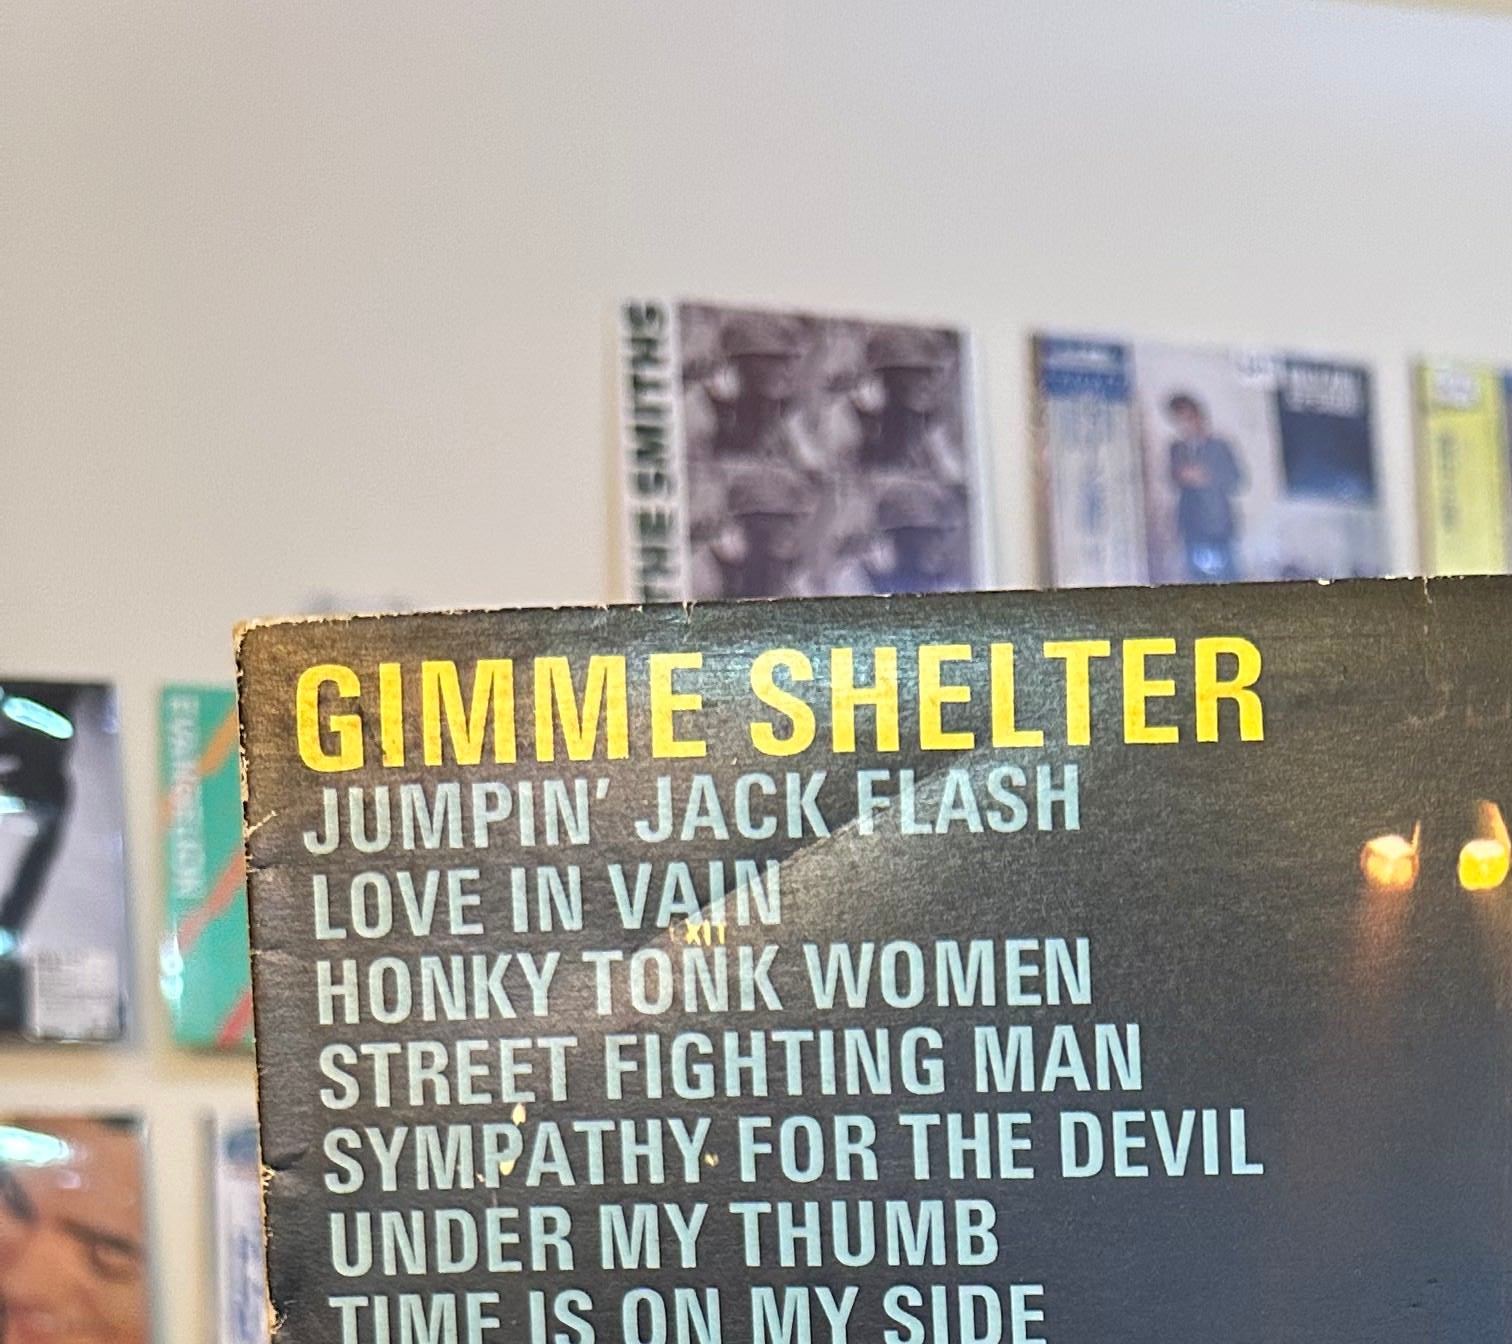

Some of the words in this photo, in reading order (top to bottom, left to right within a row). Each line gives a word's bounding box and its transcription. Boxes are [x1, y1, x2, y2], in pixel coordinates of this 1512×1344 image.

[623, 302, 675, 497] SMITHS
[294, 651, 707, 773] GIMME
[747, 636, 1265, 760] SHELTER
[301, 774, 612, 856] JUMPIN'
[633, 768, 832, 845] JACK
[855, 762, 1081, 838] FLASH
[311, 867, 484, 941] LOVE
[509, 863, 583, 934] IN
[605, 858, 783, 930] VAIN
[315, 950, 562, 1027] HONKY
[581, 943, 785, 1017] TONK
[802, 937, 1092, 1011] WOMEN
[317, 1034, 579, 1110] STREET
[603, 1026, 945, 1100] FIGHTING
[973, 1022, 1143, 1093] MAN
[322, 1117, 712, 1194] SYMPATHY
[737, 1114, 880, 1183] FOR
[898, 1112, 1036, 1181] THE
[1059, 1108, 1264, 1178] DEVIL
[329, 1205, 574, 1277] UNDER
[599, 1202, 709, 1270] MY
[728, 1199, 999, 1268] THUMB
